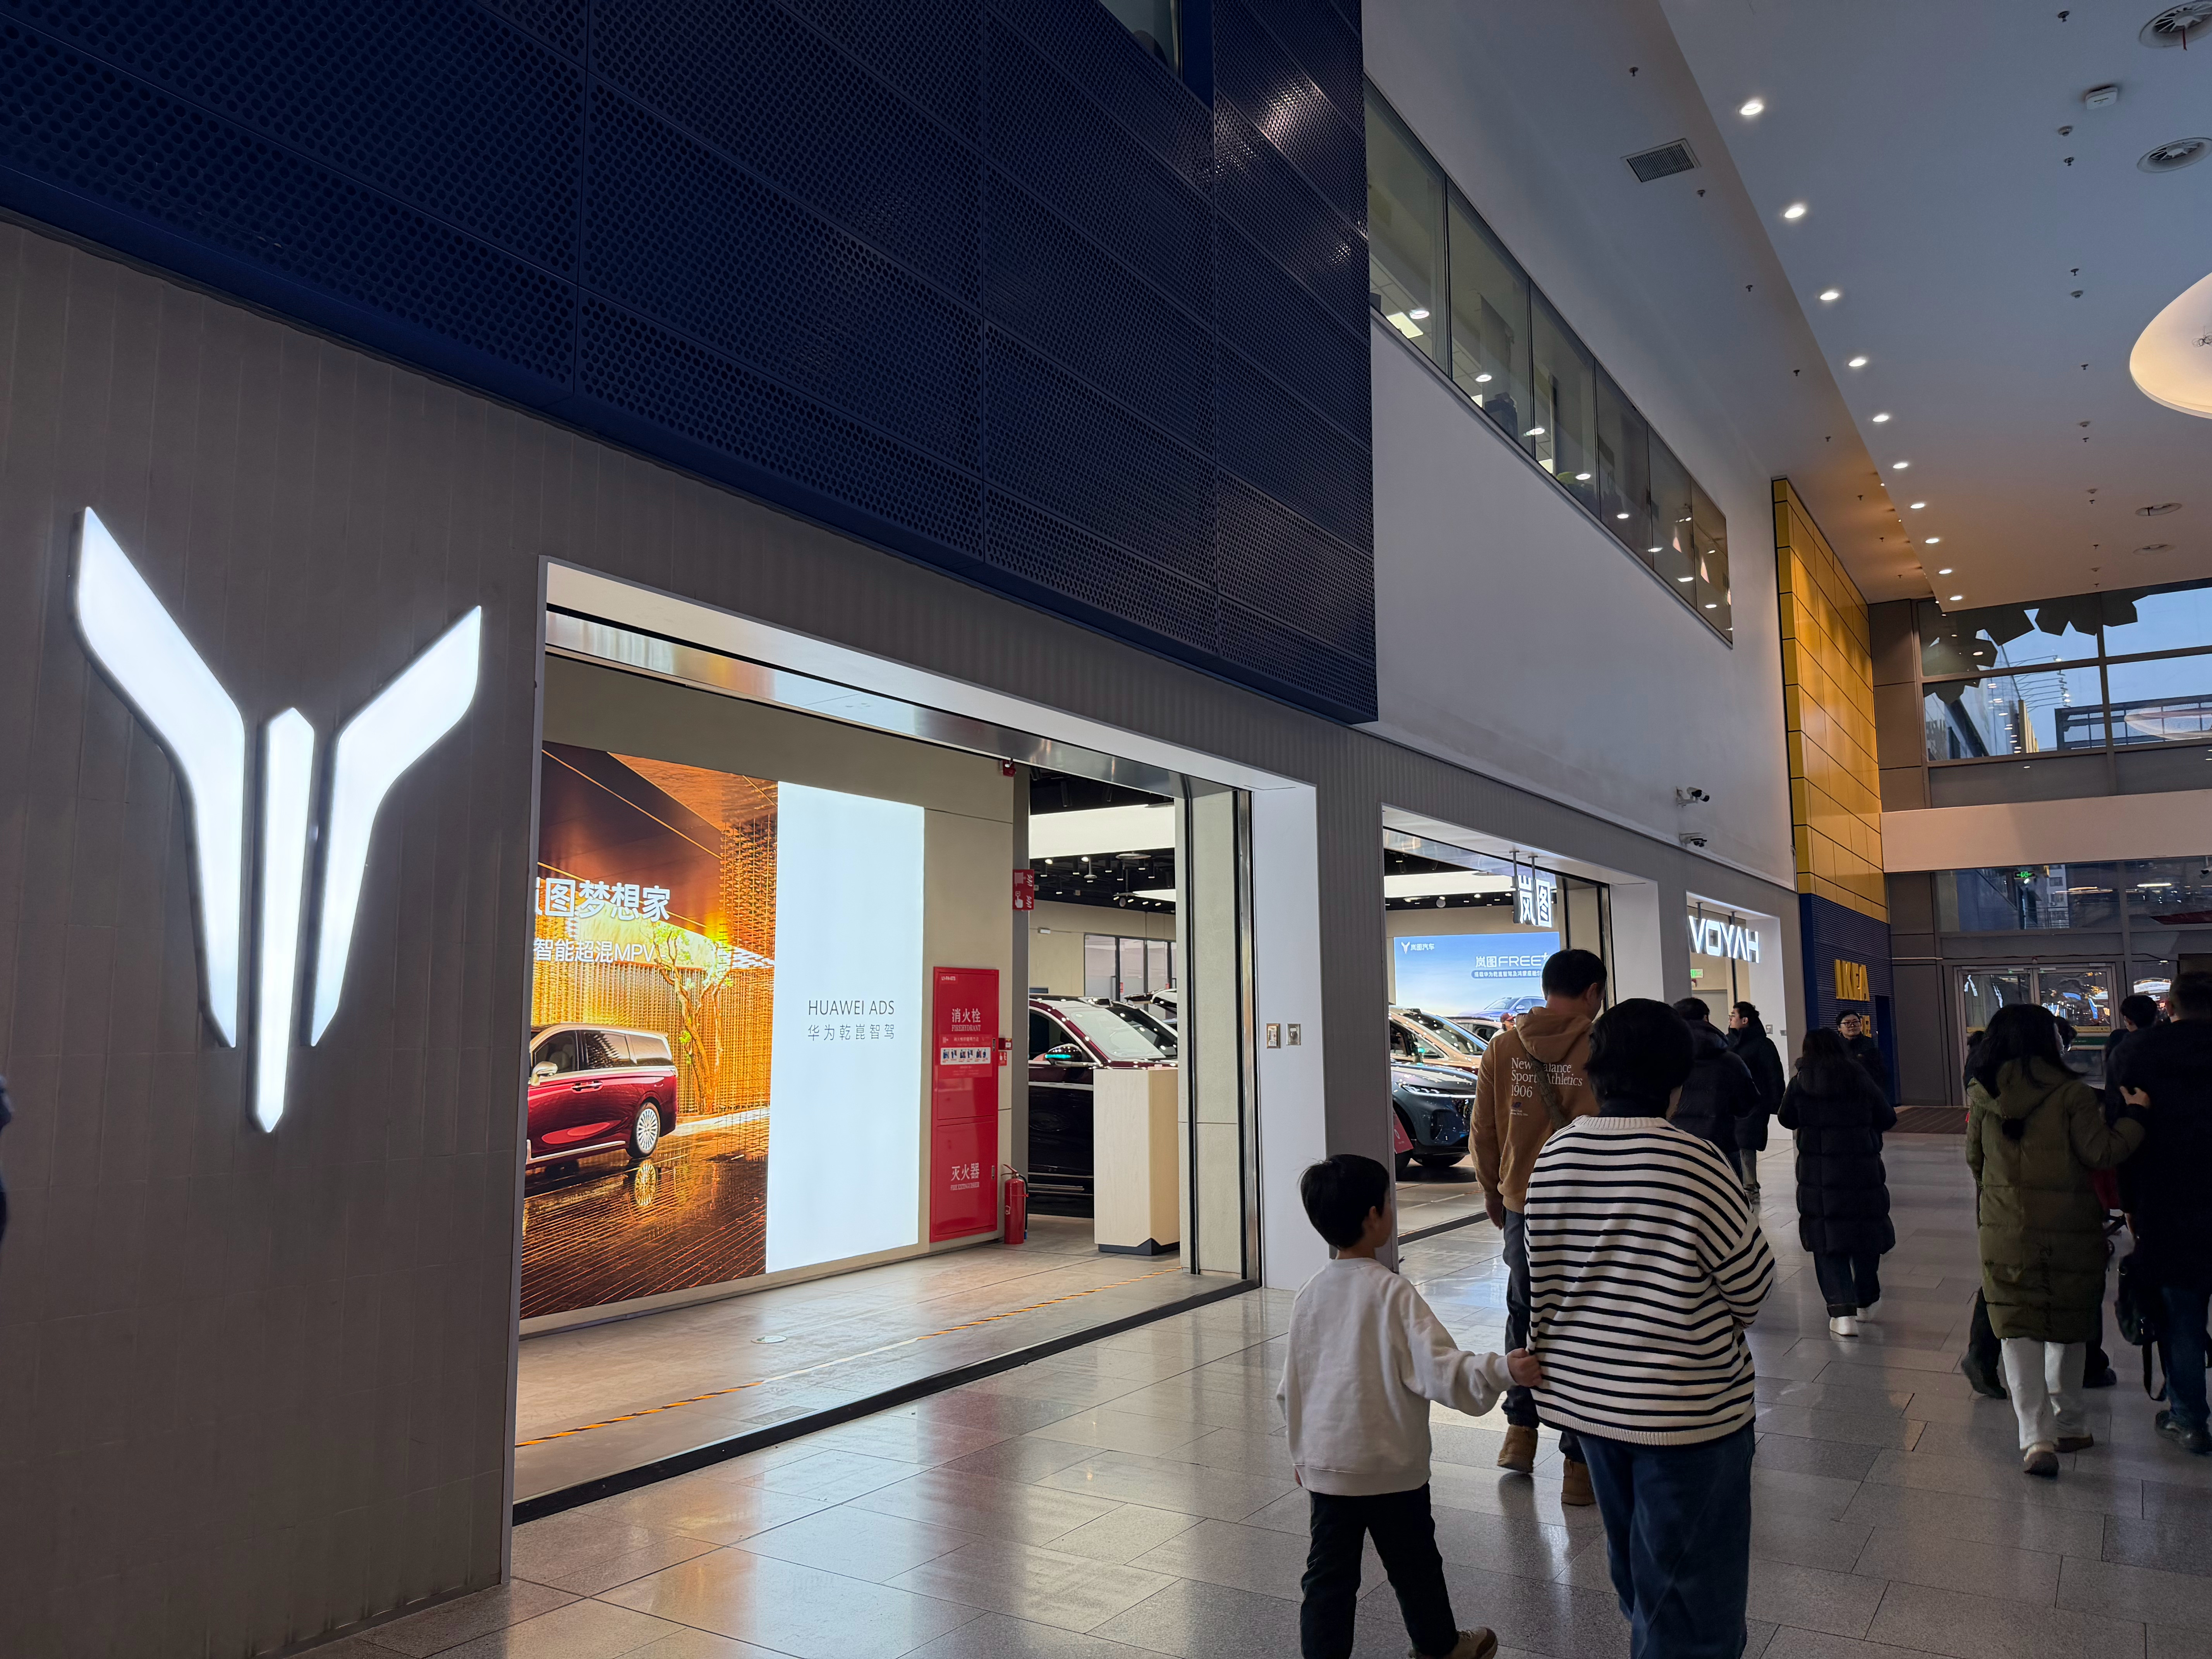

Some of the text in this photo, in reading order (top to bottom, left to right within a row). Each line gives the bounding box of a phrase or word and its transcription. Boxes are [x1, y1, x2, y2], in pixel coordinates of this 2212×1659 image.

[535, 877, 670, 922] 图梦想家
[1518, 874, 1552, 928] 岚图
[1688, 915, 1759, 964] VOYAH
[533, 937, 655, 963] 智能超混MPV
[1834, 959, 1870, 1001] IKEA
[808, 1000, 894, 1015] HUAWEI ADS
[951, 1008, 981, 1023] 消火栓
[808, 1024, 894, 1041] 华为乾崑智驾
[1511, 1057, 1572, 1073] New alance
[1511, 1069, 1537, 1085] Sport
[1511, 1084, 1533, 1098] 1906
[951, 1163, 980, 1181] 灭火器
